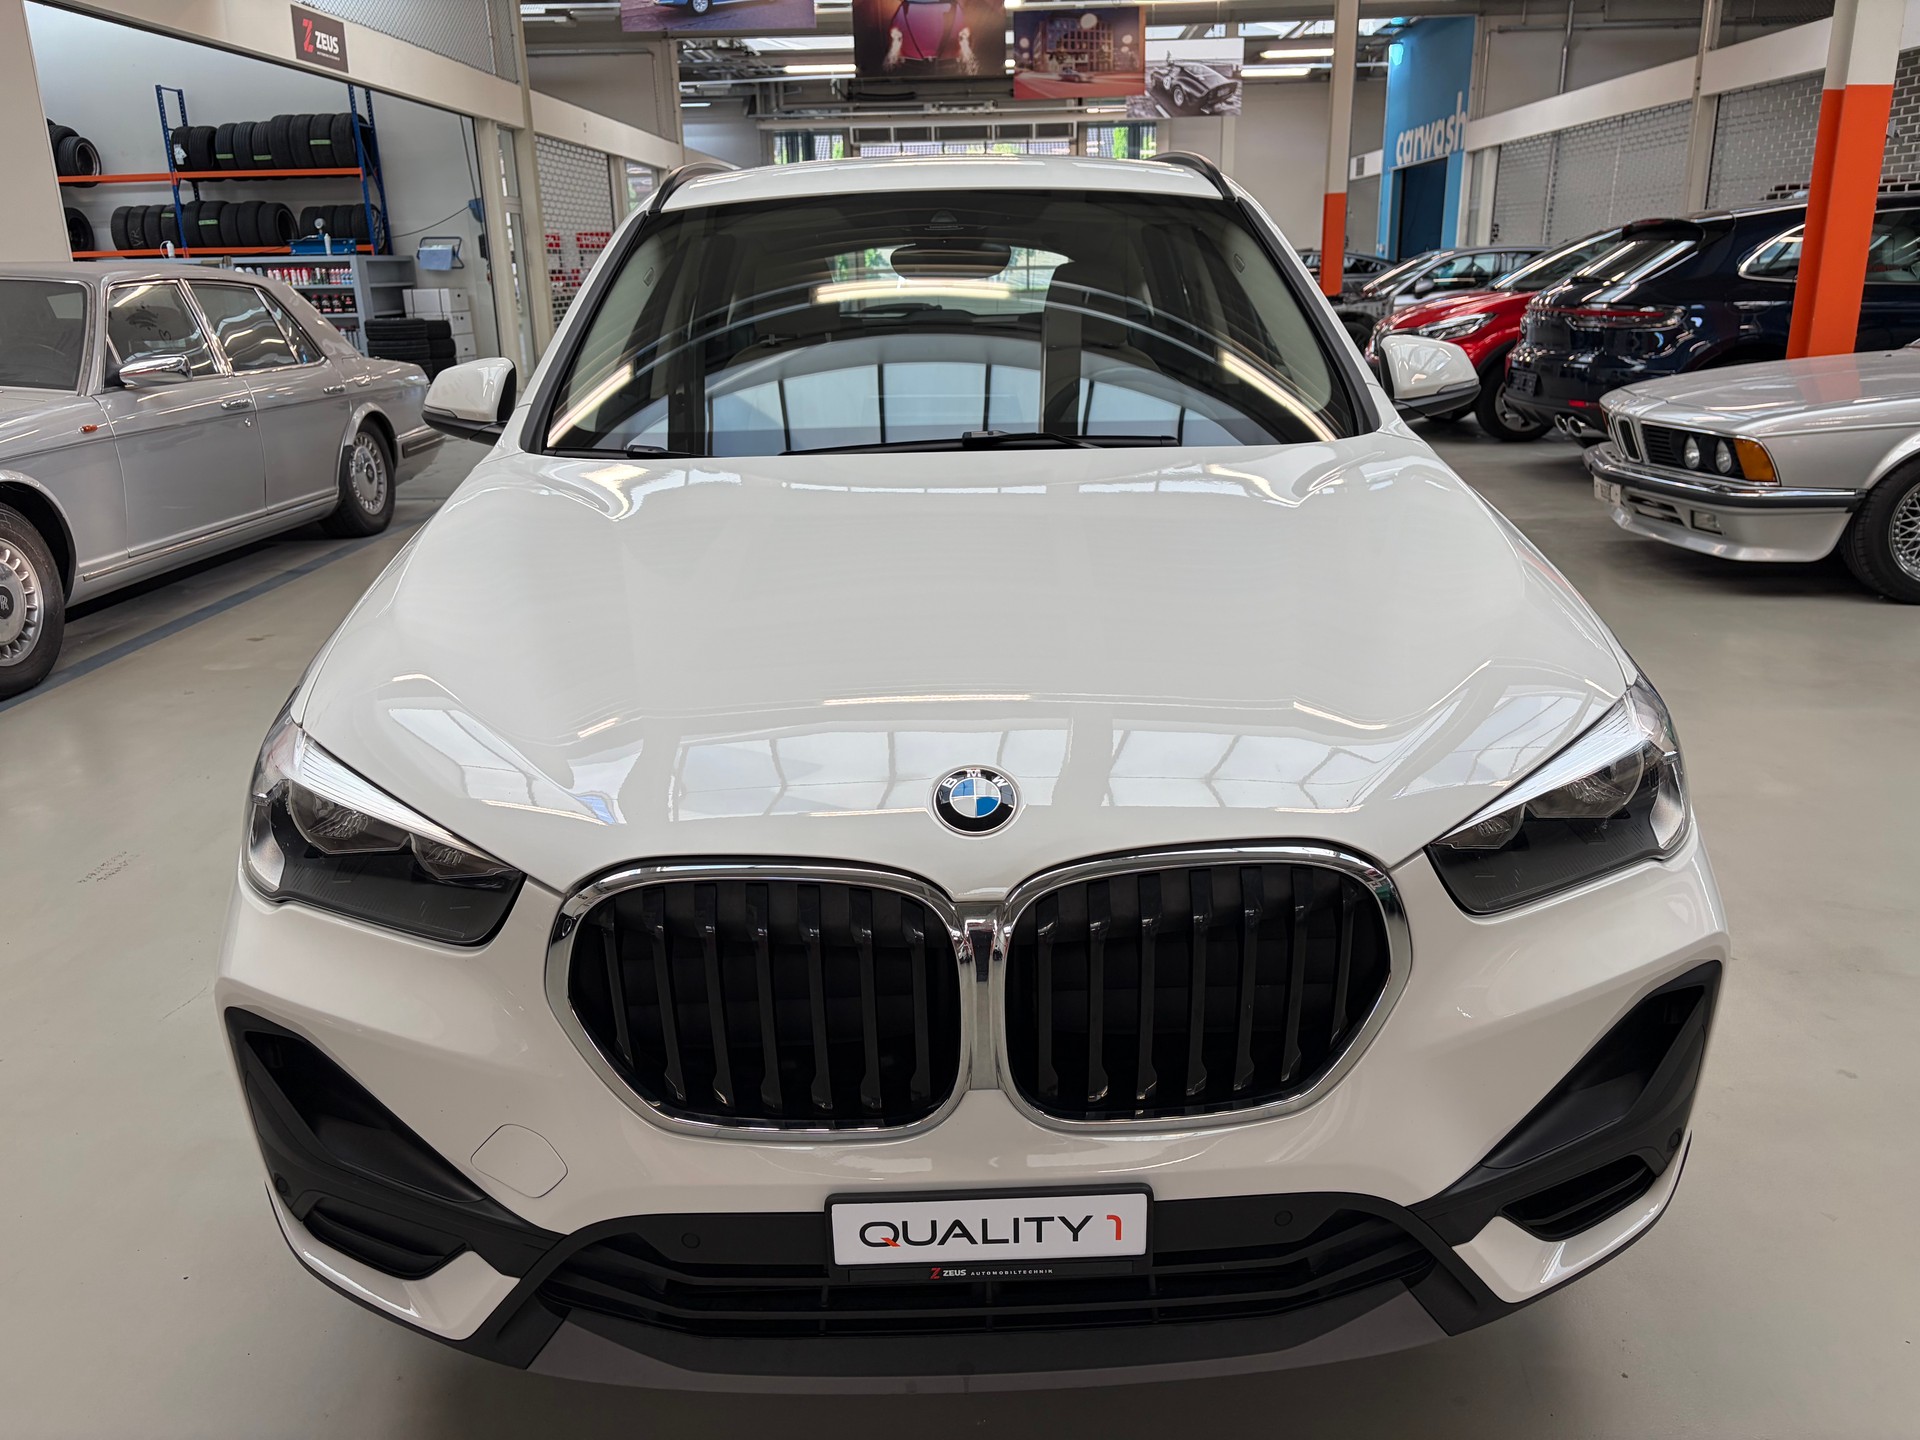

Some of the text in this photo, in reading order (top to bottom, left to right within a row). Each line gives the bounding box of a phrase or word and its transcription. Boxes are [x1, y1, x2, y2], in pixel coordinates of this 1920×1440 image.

[314, 30, 340, 54] ZEUS
[1395, 91, 1467, 166] carwash
[942, 769, 1008, 789] BMW
[859, 1214, 1122, 1248] QUALITY 1
[942, 1269, 967, 1277] ZEUS
